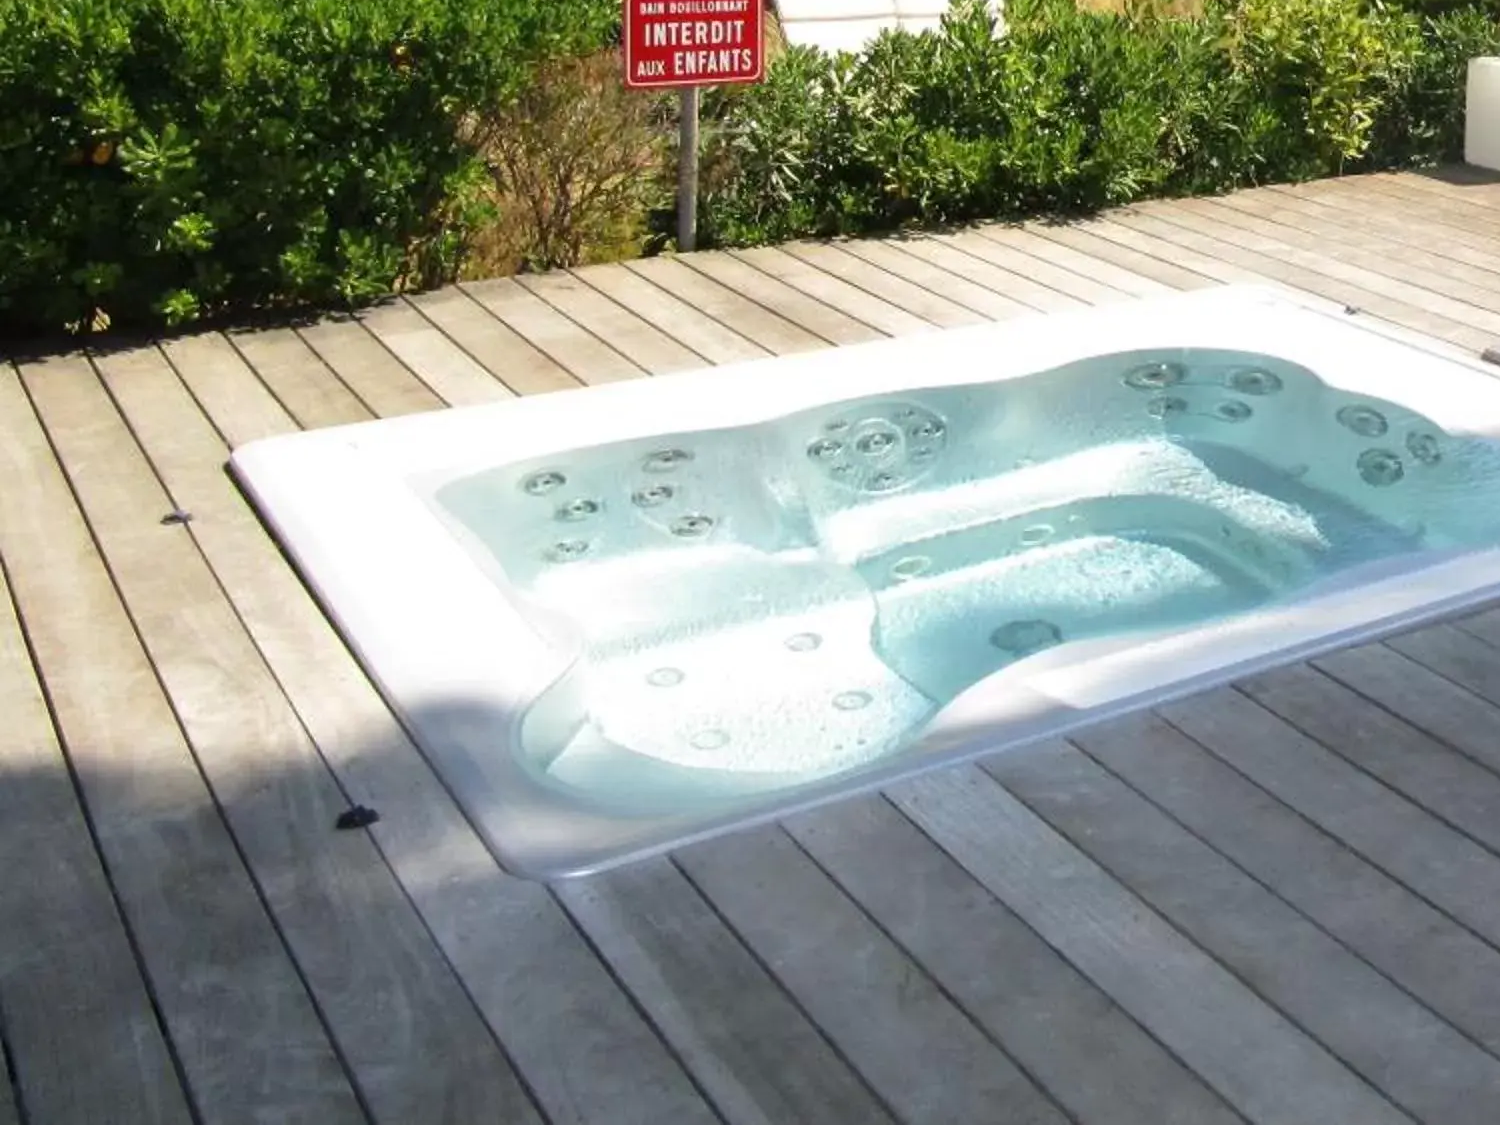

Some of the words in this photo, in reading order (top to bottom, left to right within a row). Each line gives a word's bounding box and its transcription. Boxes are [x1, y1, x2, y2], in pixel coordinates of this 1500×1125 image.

[644, 21, 745, 46] INTERDIT
[637, 61, 665, 76] AUX
[673, 49, 752, 75] ENFANTS
